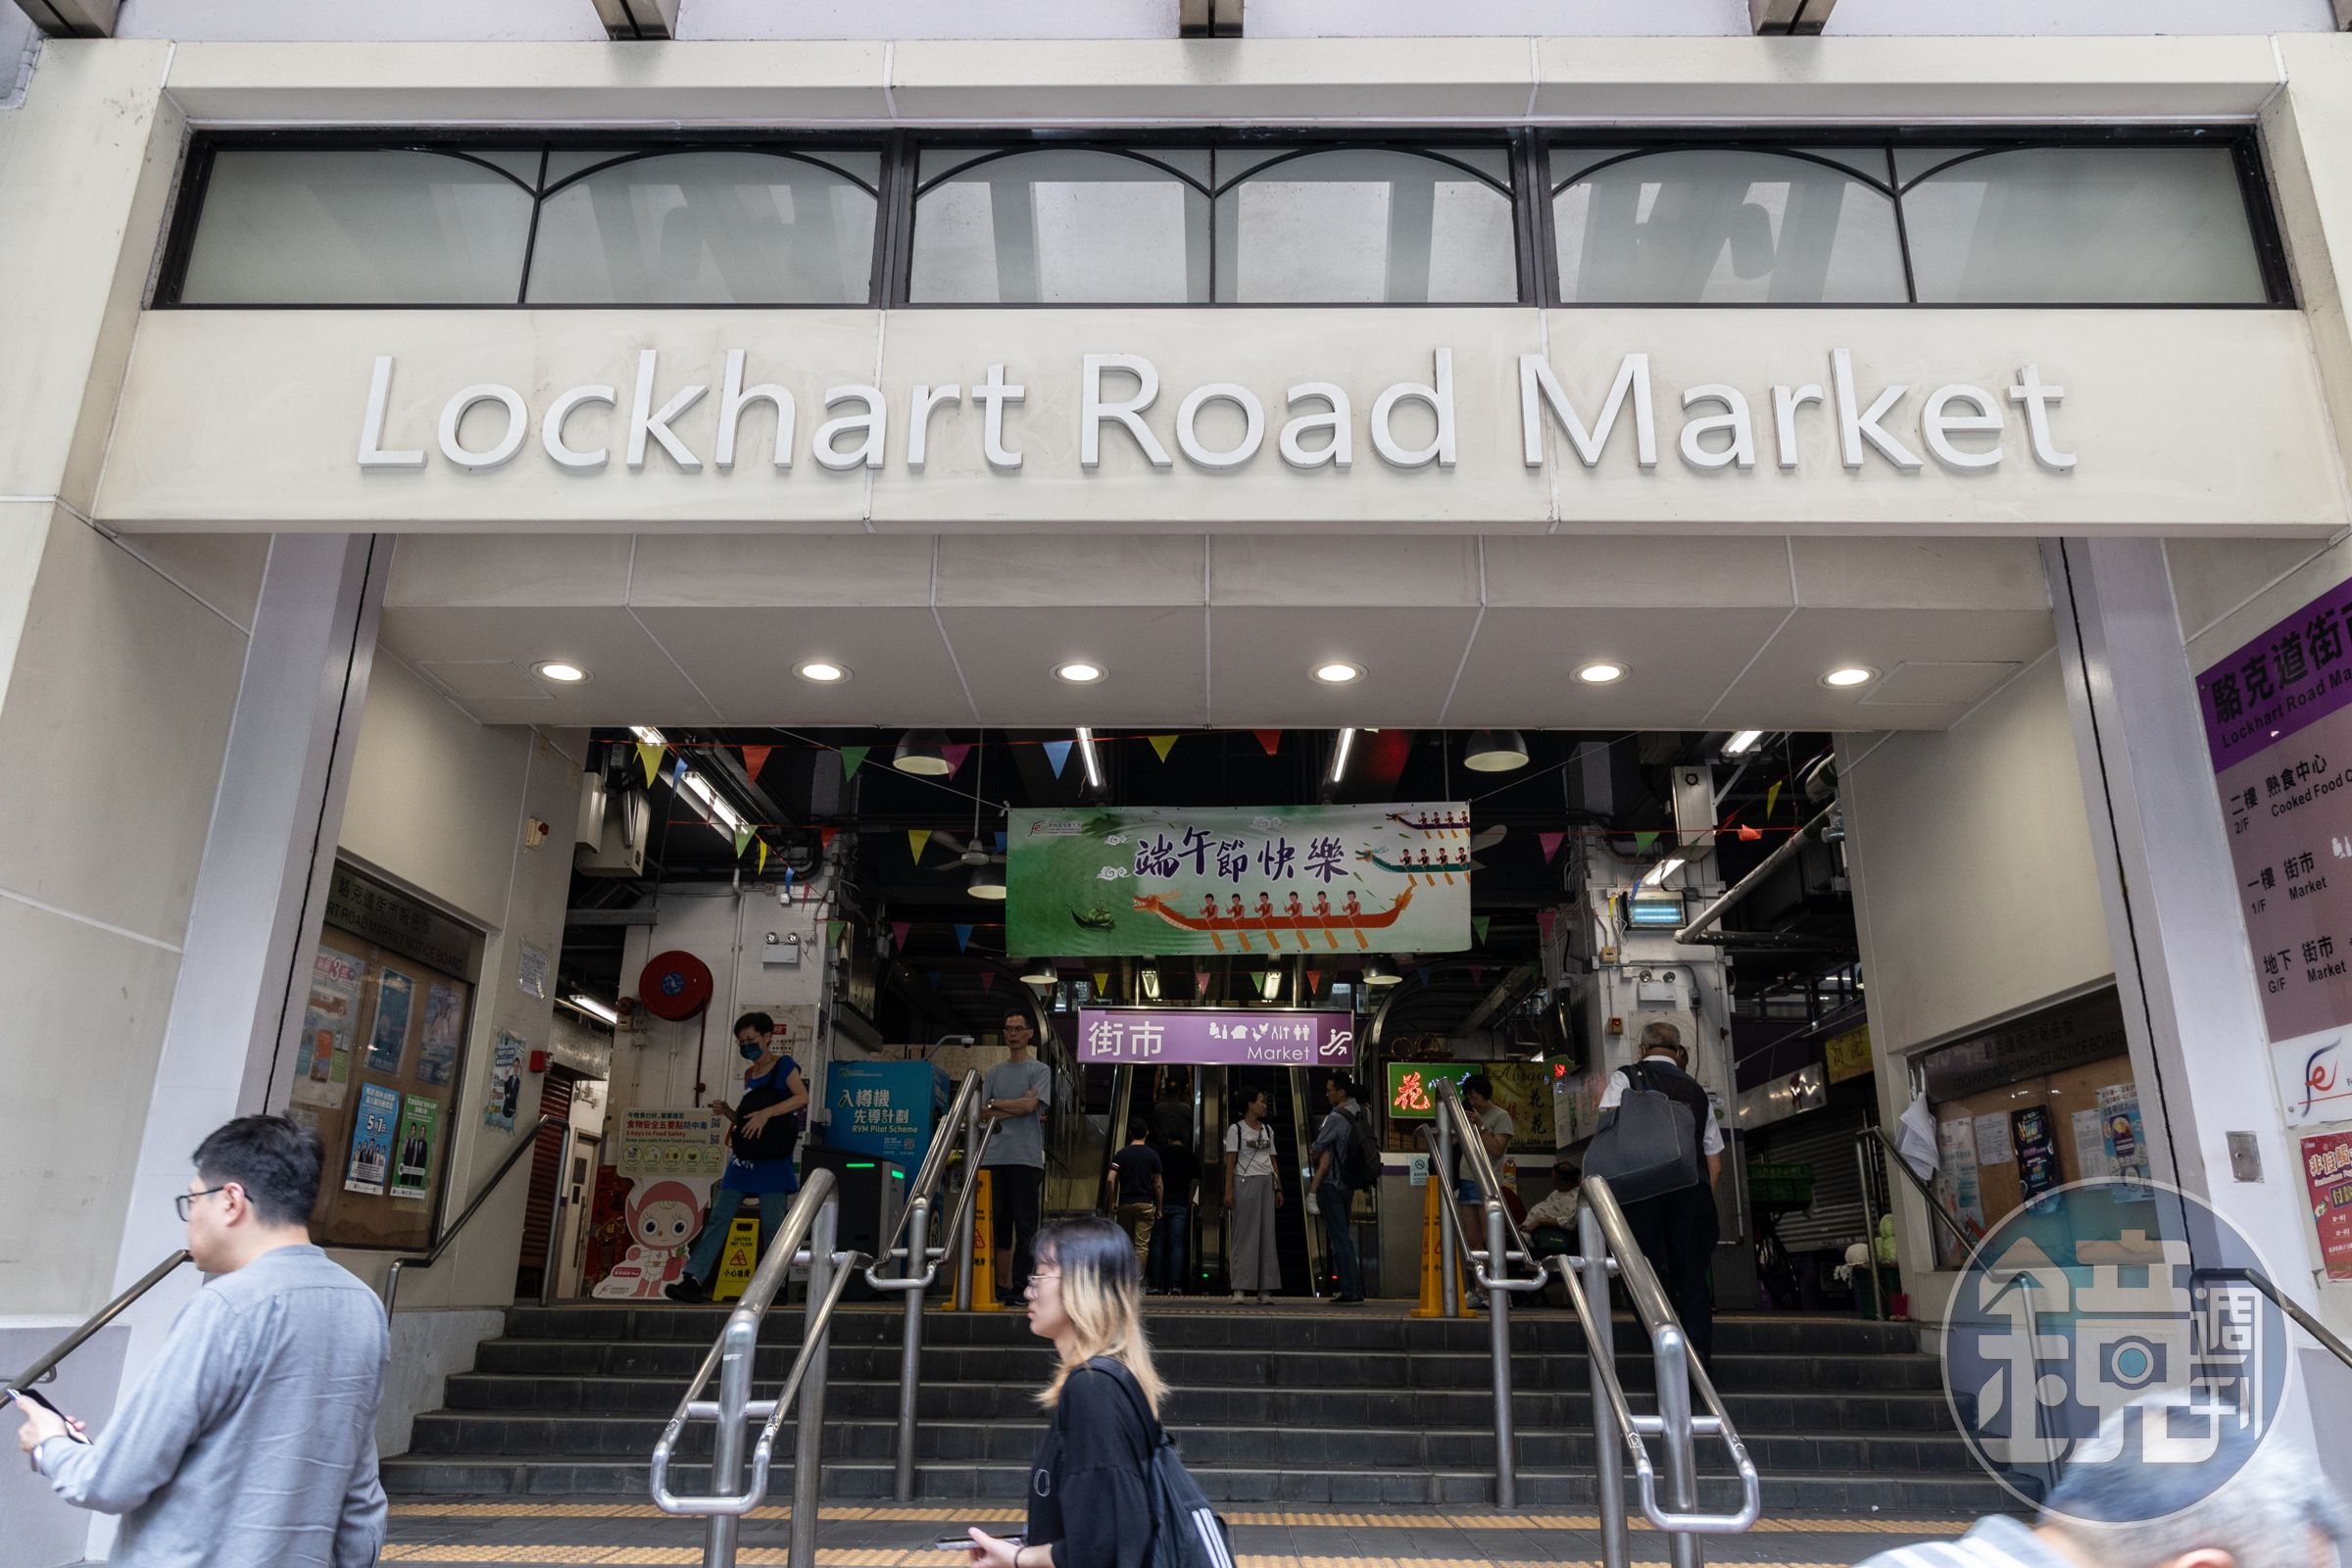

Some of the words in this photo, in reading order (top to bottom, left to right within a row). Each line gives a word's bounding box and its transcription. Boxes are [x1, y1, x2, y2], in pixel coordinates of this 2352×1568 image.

[357, 348, 1026, 470] Lockhart
[1080, 348, 1456, 470] Road
[1519, 348, 2078, 471] Market
[2222, 704, 2284, 749] Lockhart
[2286, 679, 2326, 714] Road
[2230, 786, 2259, 816] 二樓
[2266, 754, 2328, 798] 熟食中心
[2234, 817, 2250, 835] 2/F
[2271, 787, 2313, 817] Cooked
[2314, 773, 2343, 799] Food
[1135, 825, 1349, 883] 端午節快樂
[2247, 866, 2276, 892] 一樓
[2283, 851, 2315, 881] 街市
[2251, 899, 2267, 915] 1/F
[2288, 876, 2328, 901] Market
[2263, 949, 2292, 975] 地下
[2302, 936, 2334, 965] 街市
[2268, 977, 2286, 994] G/F
[2307, 960, 2347, 984] Market
[1088, 1020, 1165, 1057] 街市
[1247, 1045, 1310, 1060] Market
[837, 1089, 890, 1107] 入樽機
[1395, 1071, 1431, 1110] 花
[854, 1108, 909, 1124] 先導計劃
[724, 1269, 751, 1279] 小心地滑
